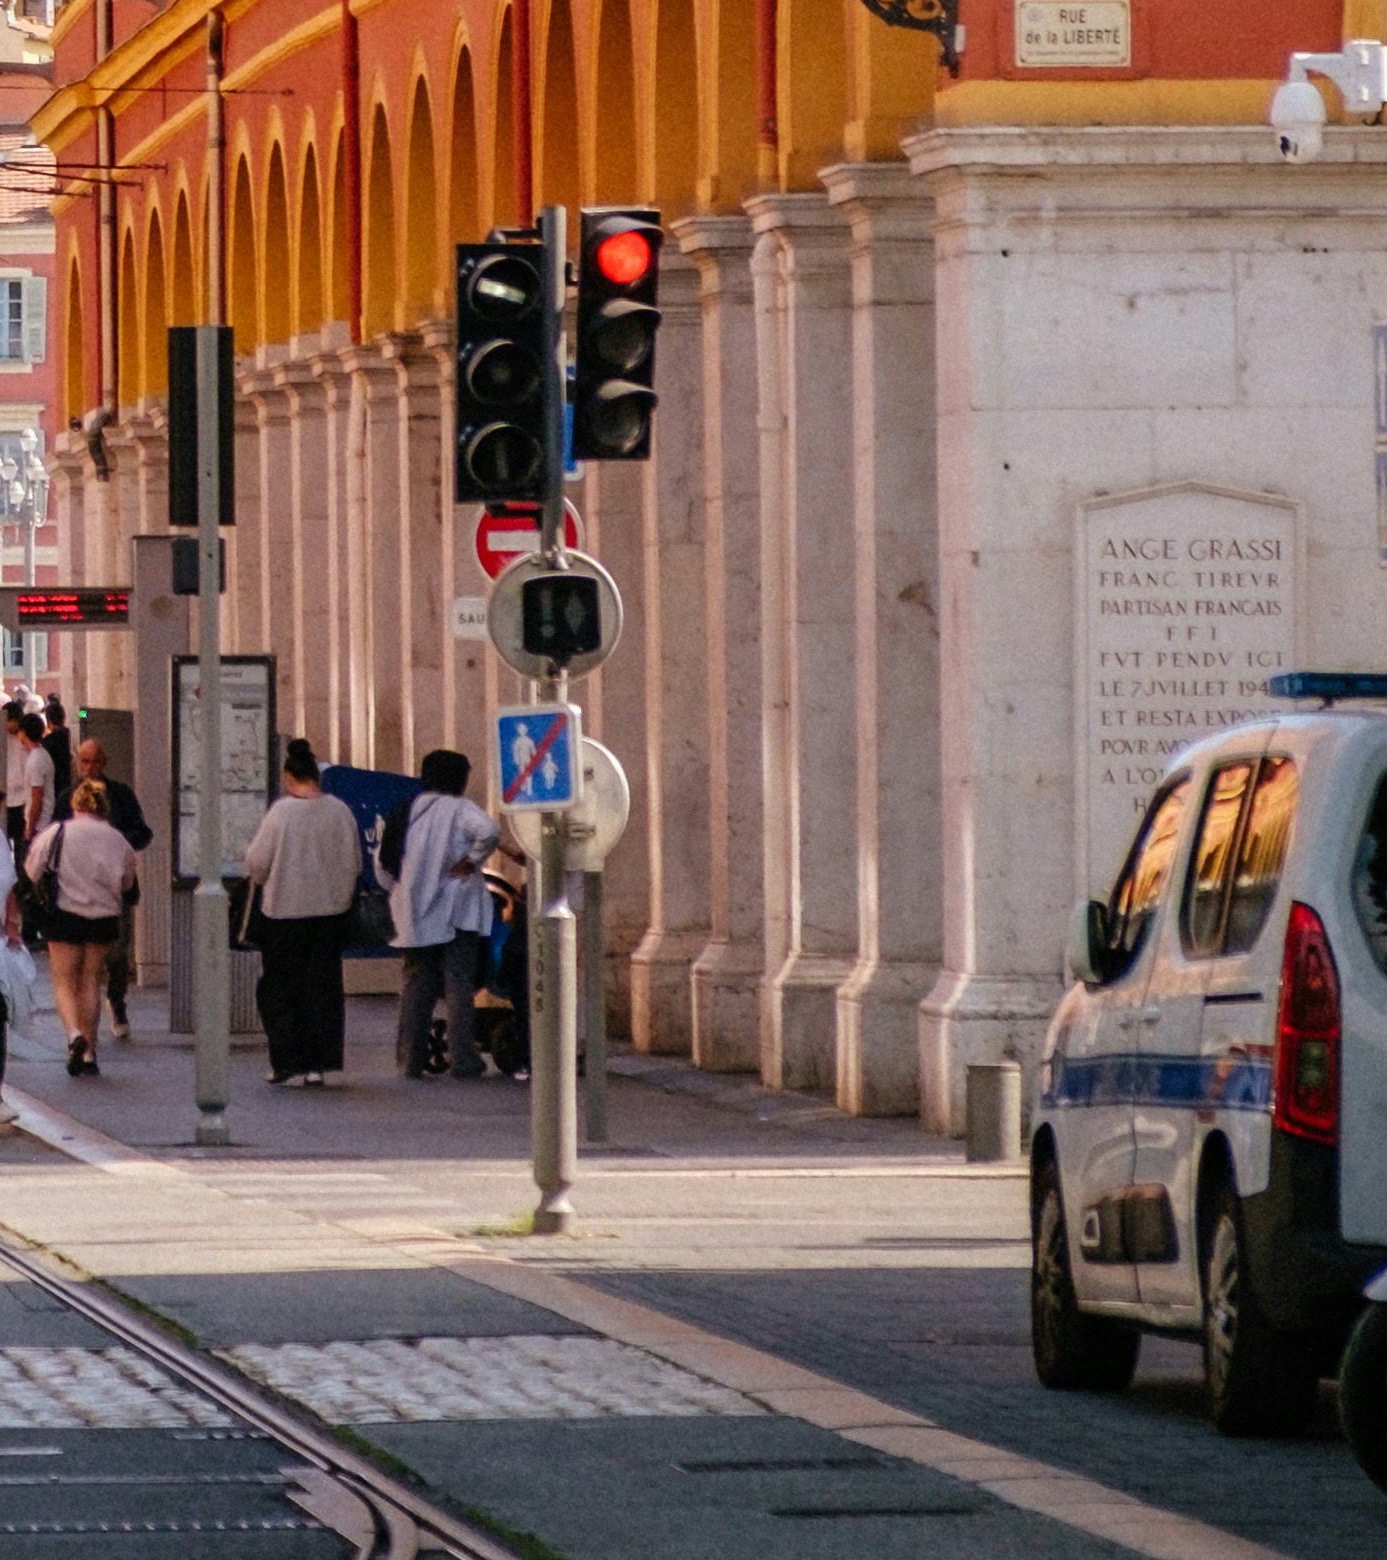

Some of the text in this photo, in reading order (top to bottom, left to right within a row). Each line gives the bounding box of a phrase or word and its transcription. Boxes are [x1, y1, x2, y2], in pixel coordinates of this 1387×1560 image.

[1059, 10, 1087, 23] RUE
[1026, 28, 1120, 44] de la LIBERTÉ
[1101, 538, 1282, 561] ANGE GRASSI
[1100, 572, 1279, 588] FRANC TIREVR
[1100, 600, 1187, 616] PARTISAN
[458, 614, 486, 624] SAU
[1100, 652, 1283, 668] FVT PENDV ICI
[1100, 681, 1269, 697] LE 7 JVILLET 194
[1101, 710, 1124, 726] ET
[1137, 710, 1196, 726] RESTA
[1101, 739, 1148, 755] POVR
[1102, 769, 1115, 784] A
